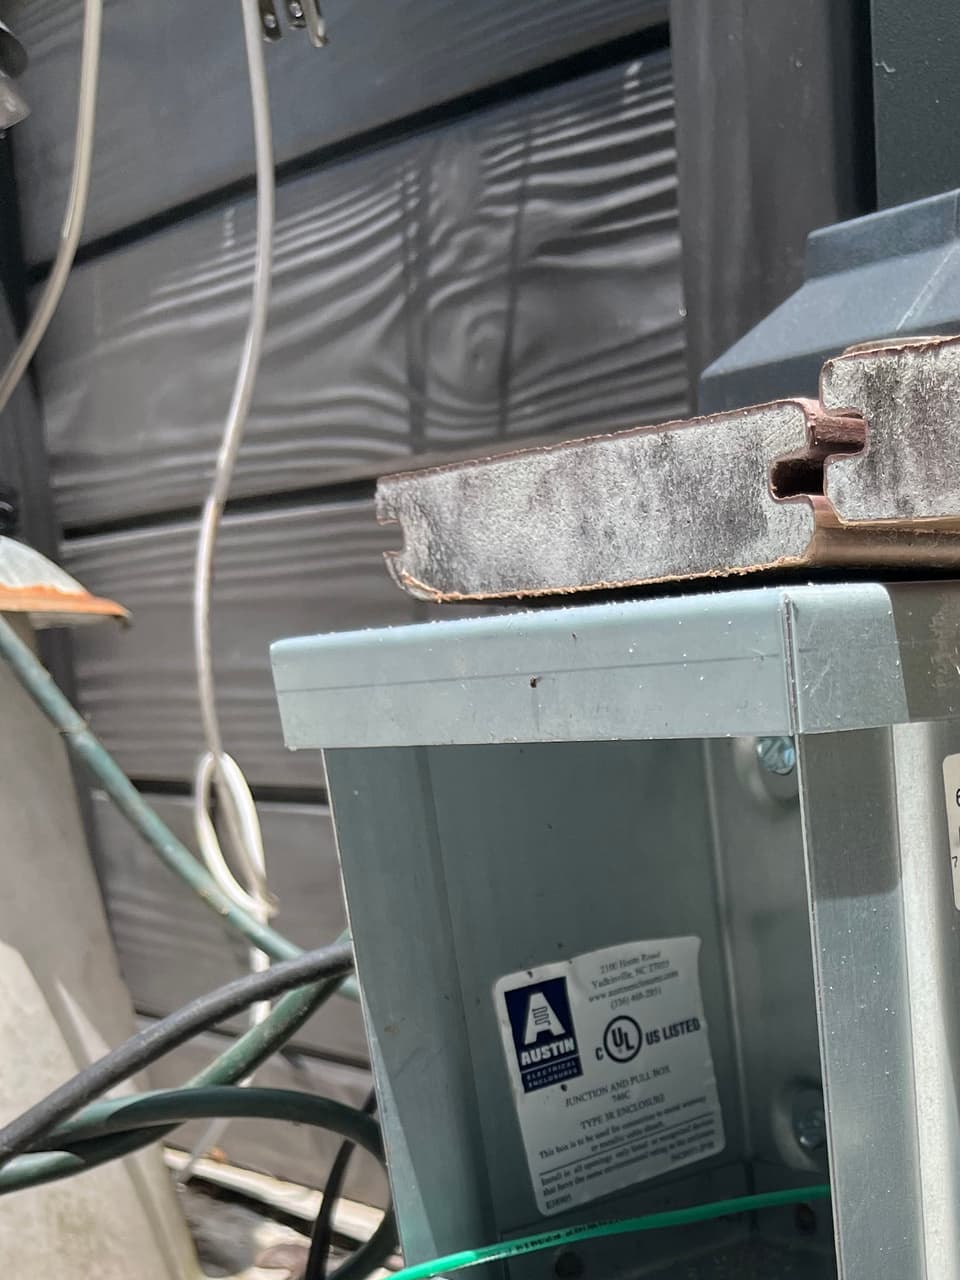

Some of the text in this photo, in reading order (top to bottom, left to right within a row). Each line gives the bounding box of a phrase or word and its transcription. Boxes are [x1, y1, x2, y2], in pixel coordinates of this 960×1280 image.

[951, 856, 959, 868] 7
[611, 1026, 635, 1051] UL
[645, 1031, 661, 1046] US
[661, 1017, 701, 1041] LISTED
[521, 1037, 576, 1066] AUSTIN
[564, 1086, 609, 1108] JUNCTION
[610, 1078, 630, 1092] AND
[580, 1114, 603, 1130] TYPE
